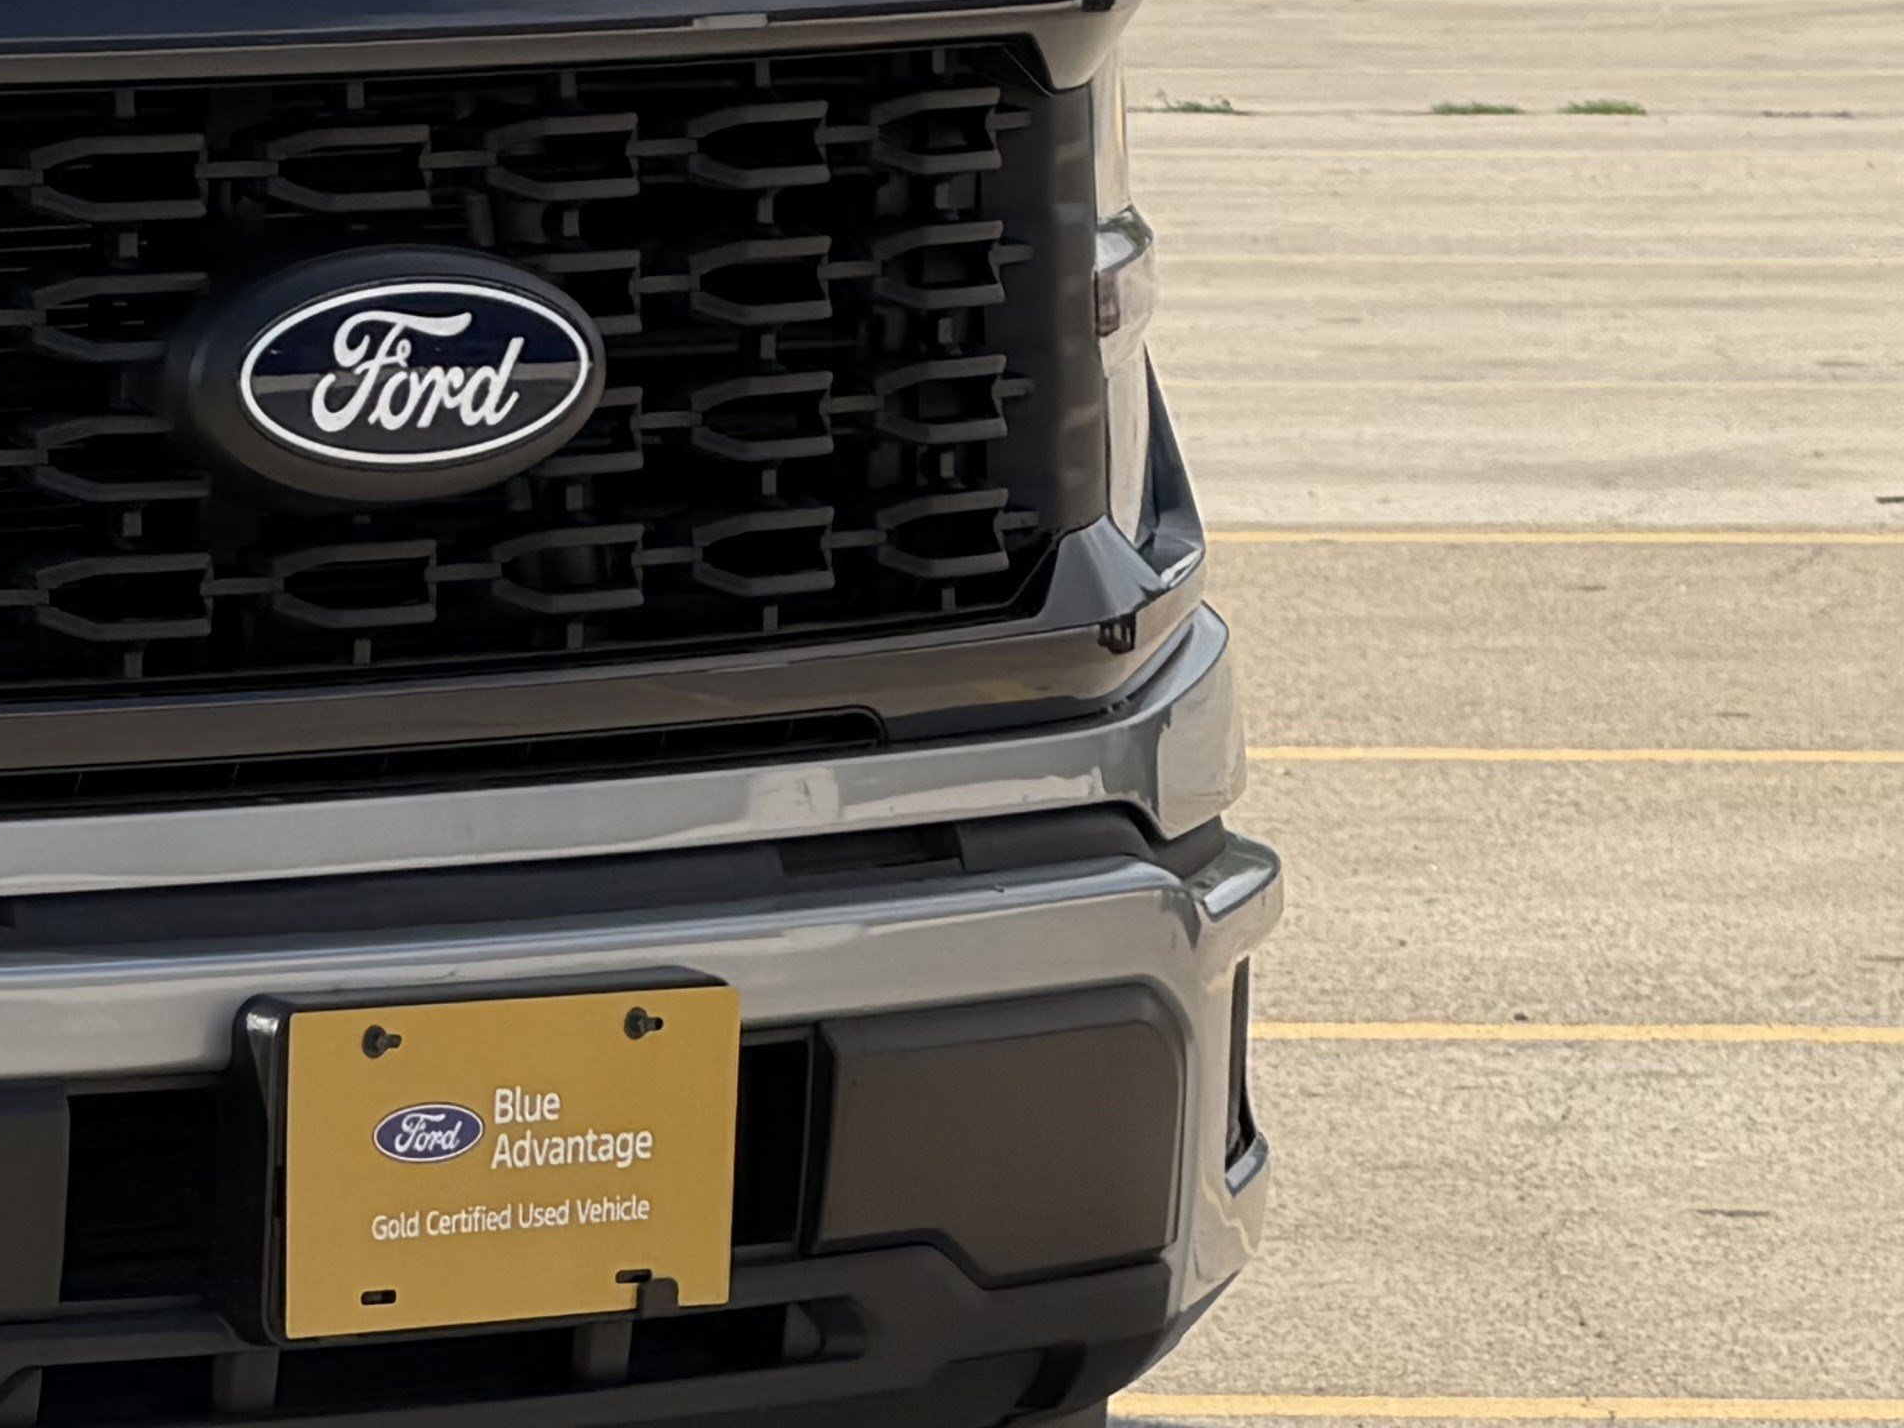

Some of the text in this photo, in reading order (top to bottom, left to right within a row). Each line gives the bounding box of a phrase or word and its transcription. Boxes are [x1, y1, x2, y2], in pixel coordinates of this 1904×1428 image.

[310, 309, 526, 433] Ford
[393, 1087, 561, 1153] Ford Blue
[491, 1128, 654, 1170] Advantage
[370, 1193, 651, 1241] Gold Certified Used Vehicle
